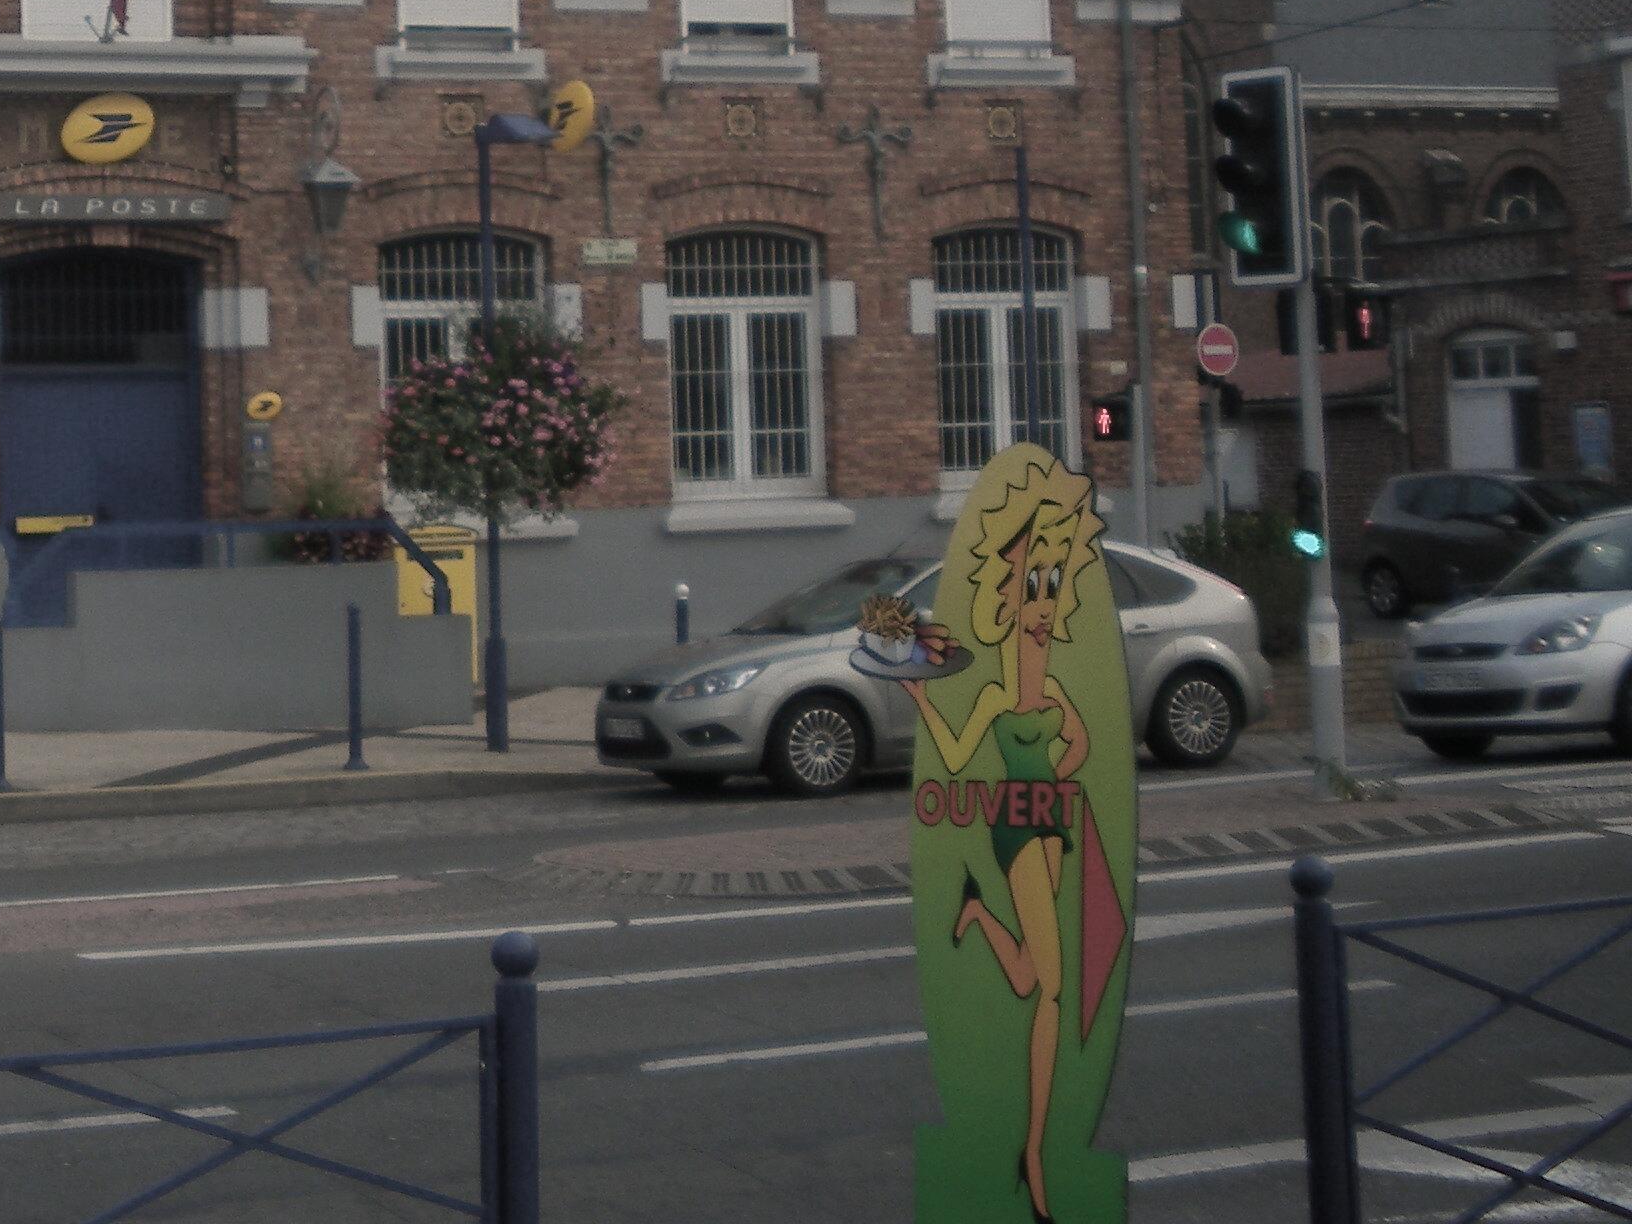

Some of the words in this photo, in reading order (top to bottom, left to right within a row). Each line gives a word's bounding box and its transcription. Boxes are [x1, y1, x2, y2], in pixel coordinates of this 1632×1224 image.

[16, 198, 60, 215] LA
[85, 197, 211, 216] POSTE
[915, 779, 1080, 827] OUVERT
